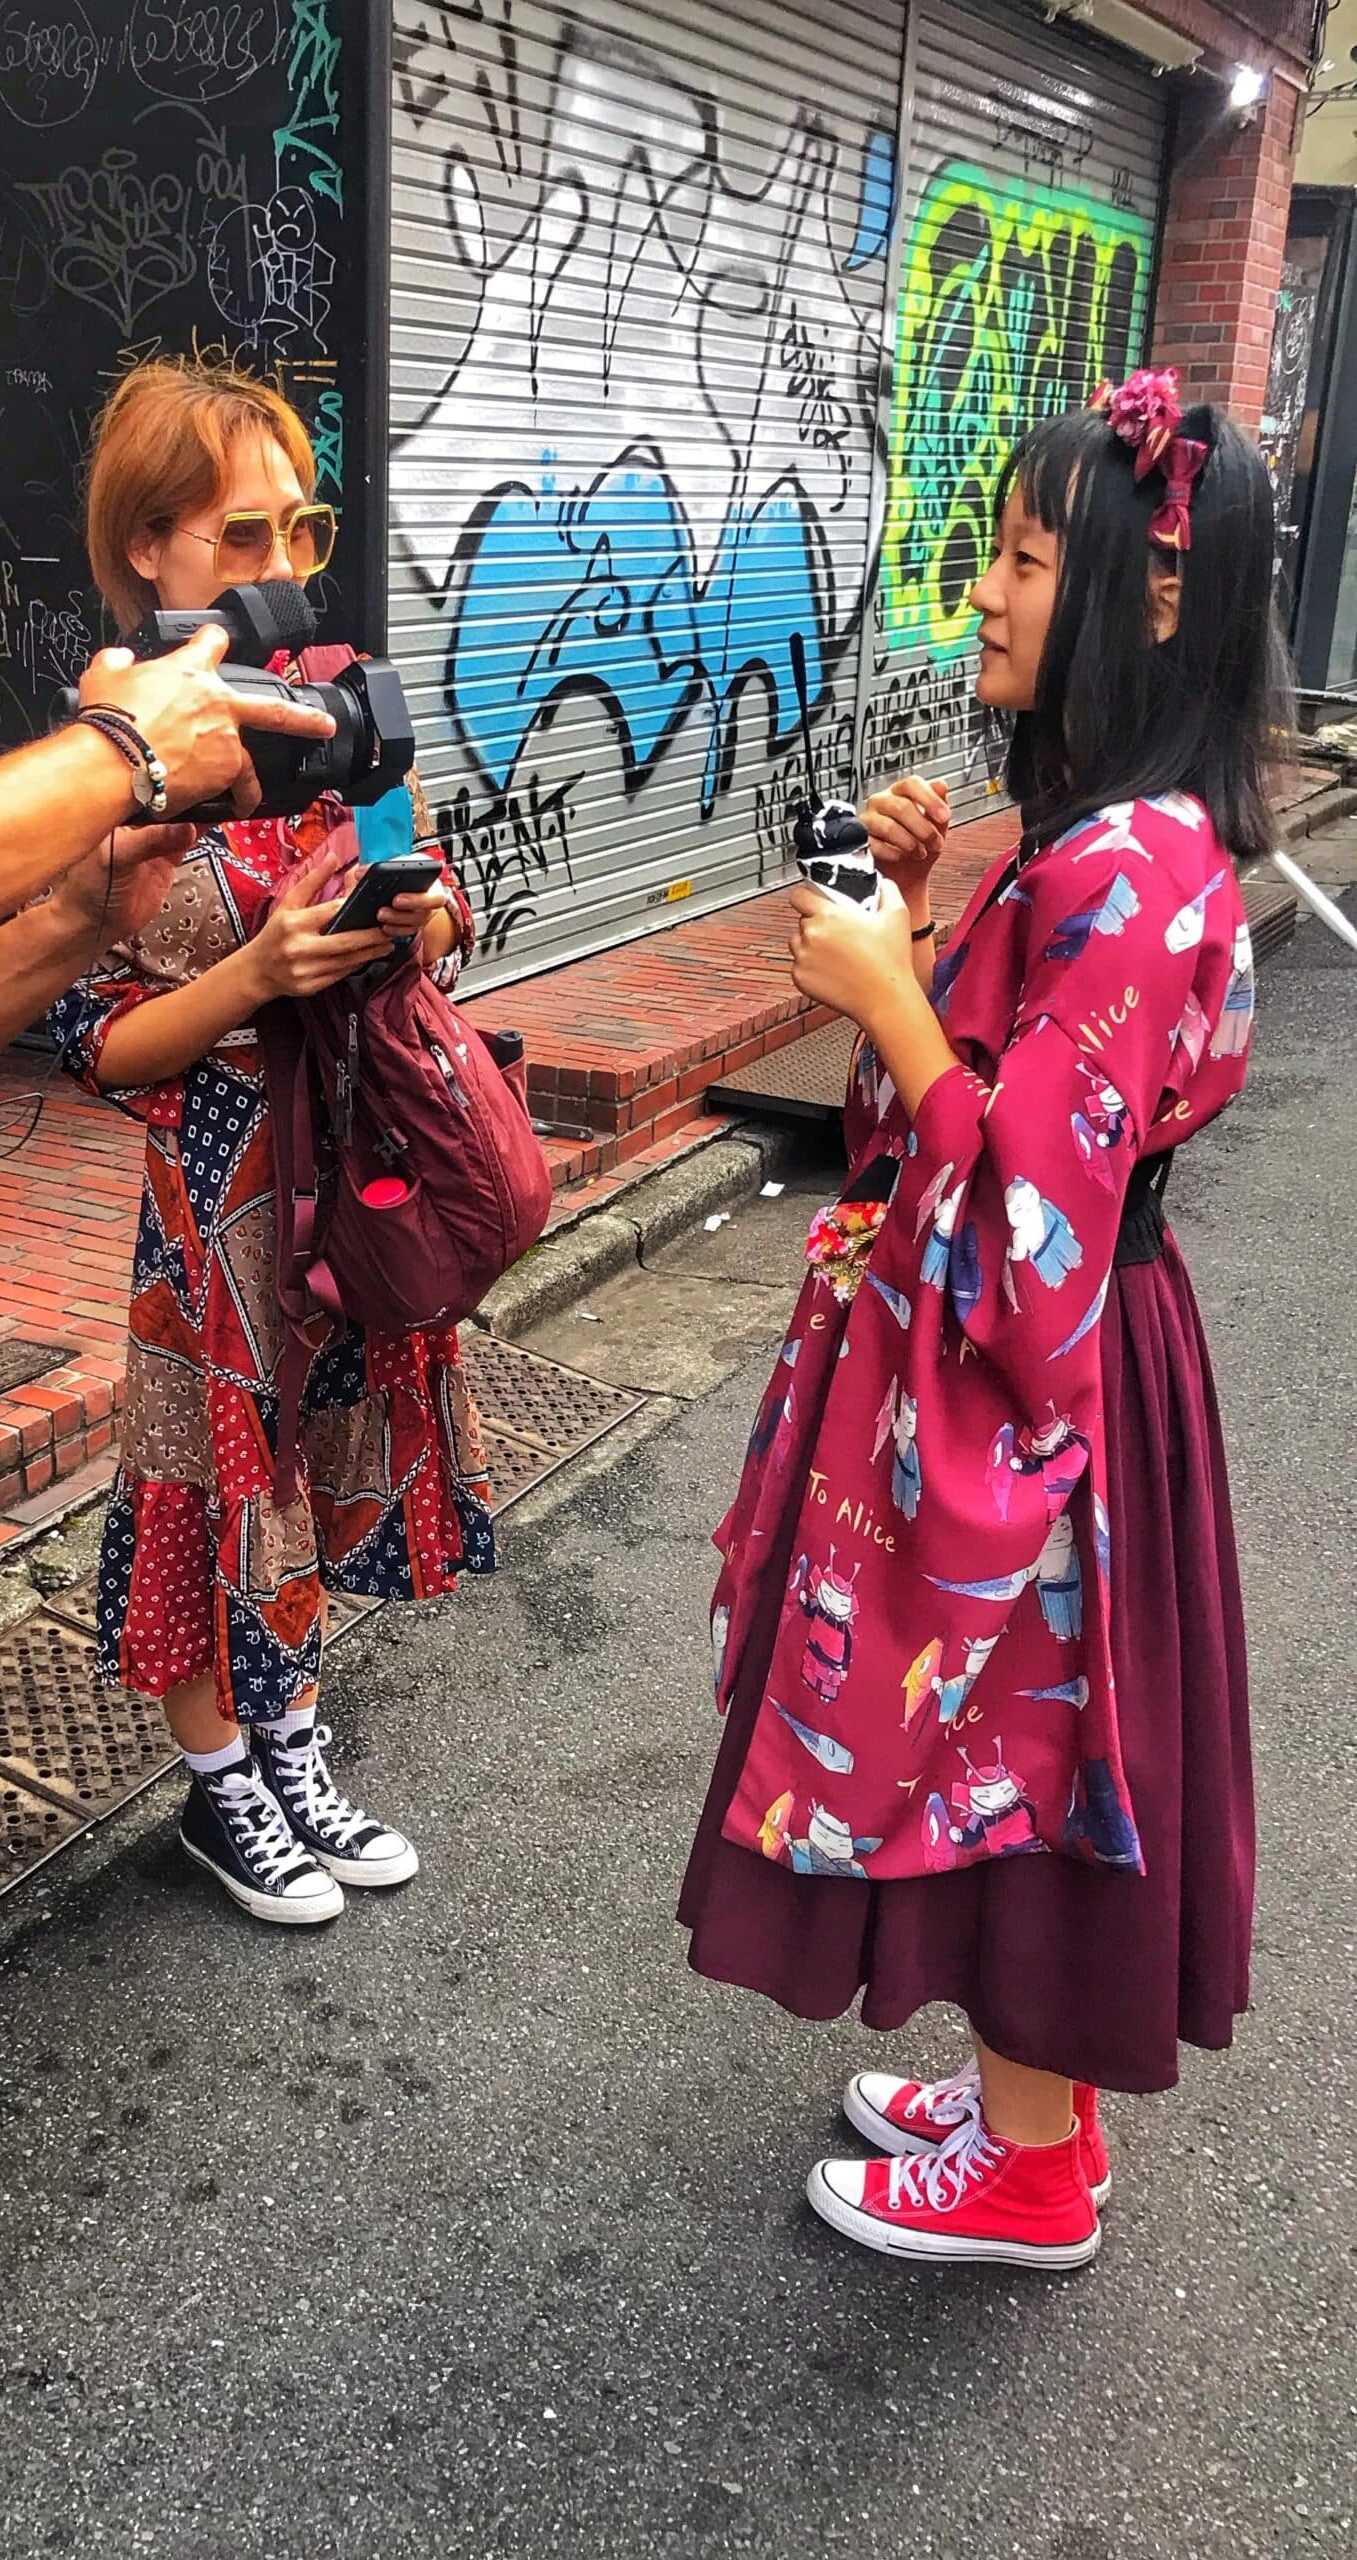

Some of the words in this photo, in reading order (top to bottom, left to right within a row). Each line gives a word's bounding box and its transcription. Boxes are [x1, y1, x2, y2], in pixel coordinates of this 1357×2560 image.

[1077, 985, 1140, 1054] lice
[809, 1468, 830, 1505] To
[836, 1497, 896, 1553] Alice
